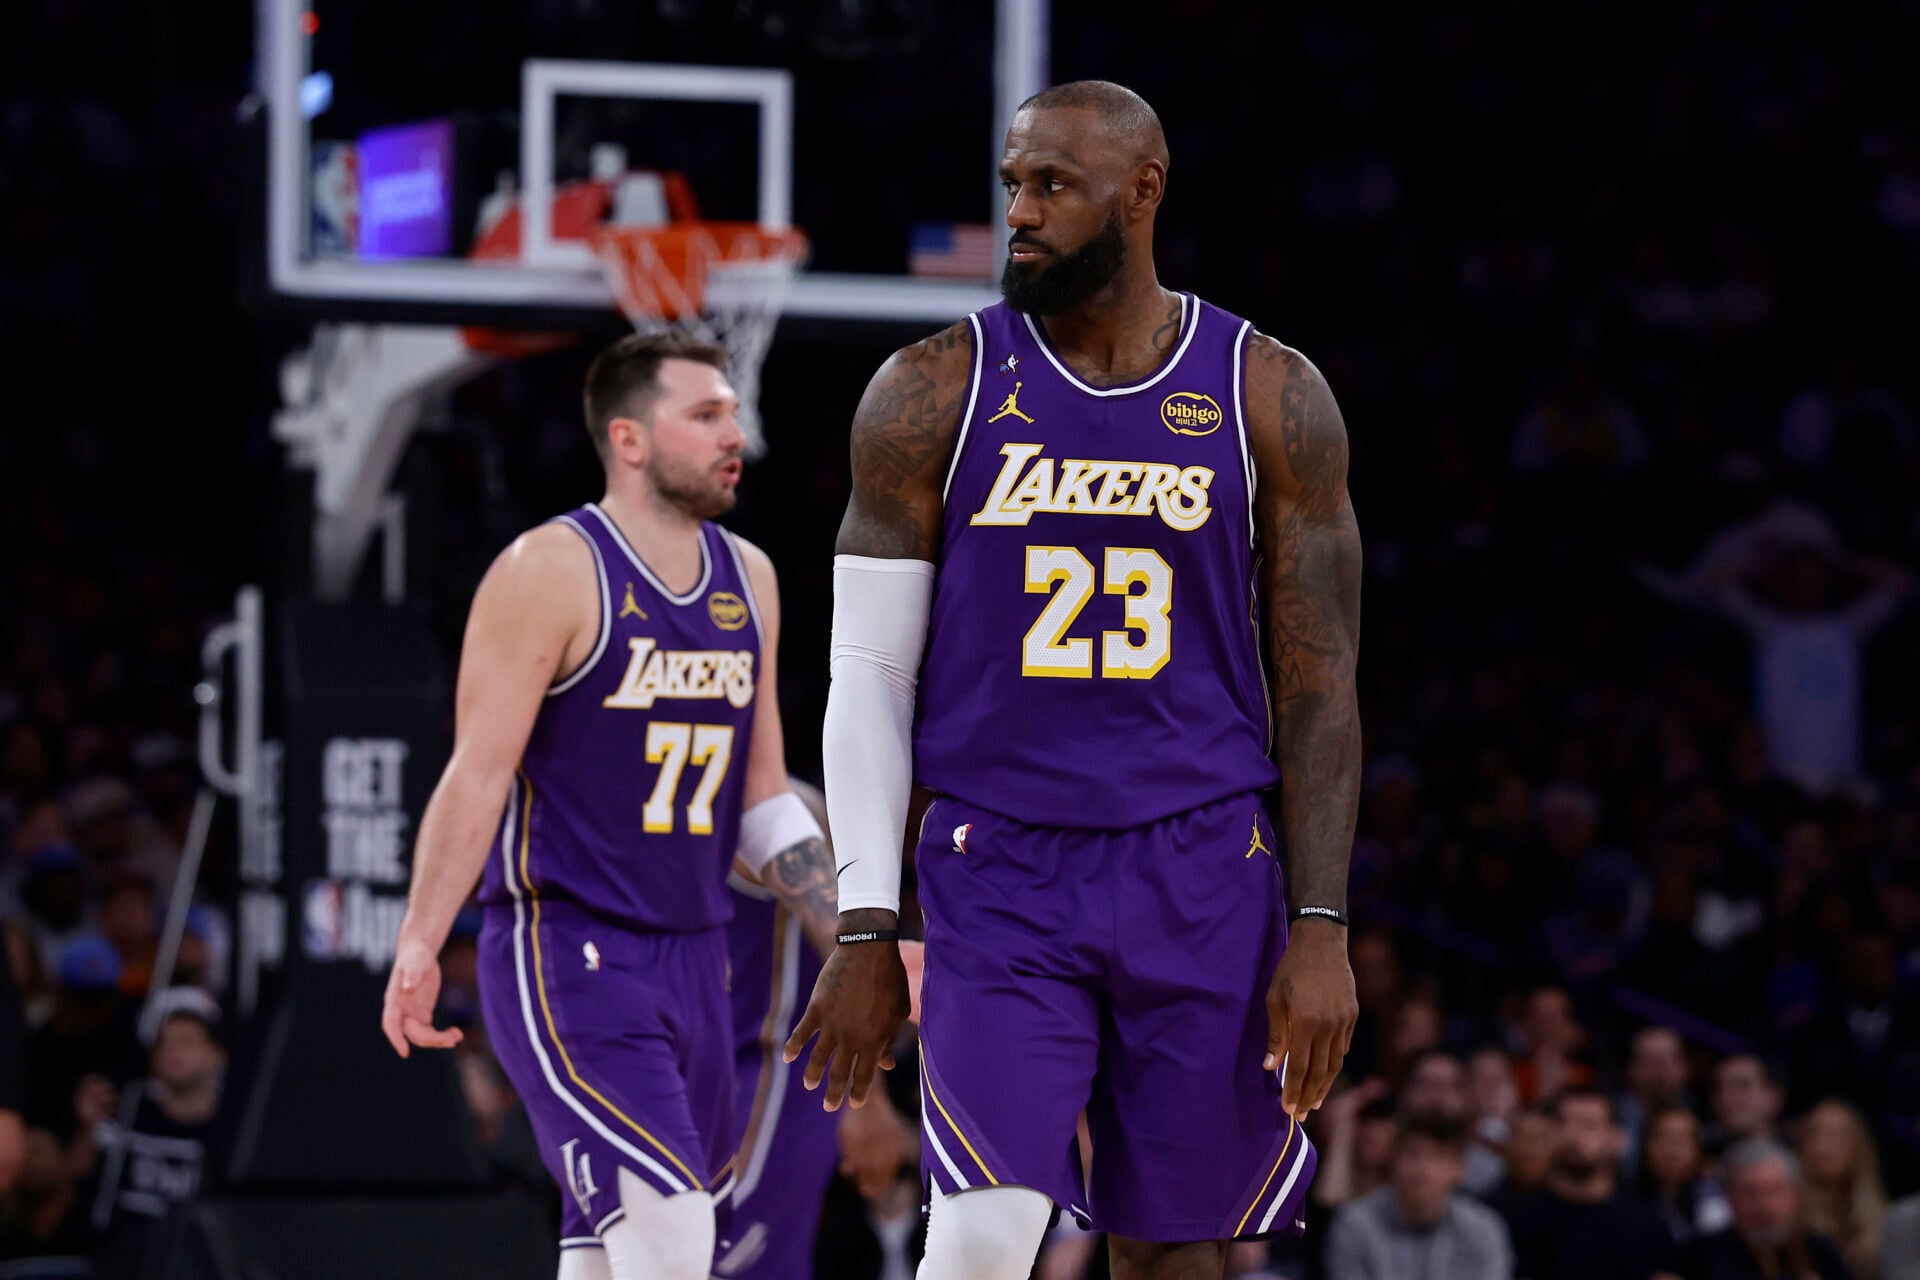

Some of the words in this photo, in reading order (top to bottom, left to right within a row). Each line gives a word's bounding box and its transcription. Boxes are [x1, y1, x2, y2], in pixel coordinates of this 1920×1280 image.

[1166, 402, 1218, 424] bibigo
[1175, 417, 1198, 427] 비비고
[970, 443, 1215, 531] LAKERS
[1022, 545, 1174, 680] 23
[602, 637, 754, 709] LAKERS
[323, 737, 408, 805] GET
[642, 721, 735, 836] 77
[322, 811, 408, 881] THE
[838, 932, 872, 942] PROMISE
[1300, 906, 1335, 916] PROMISE
